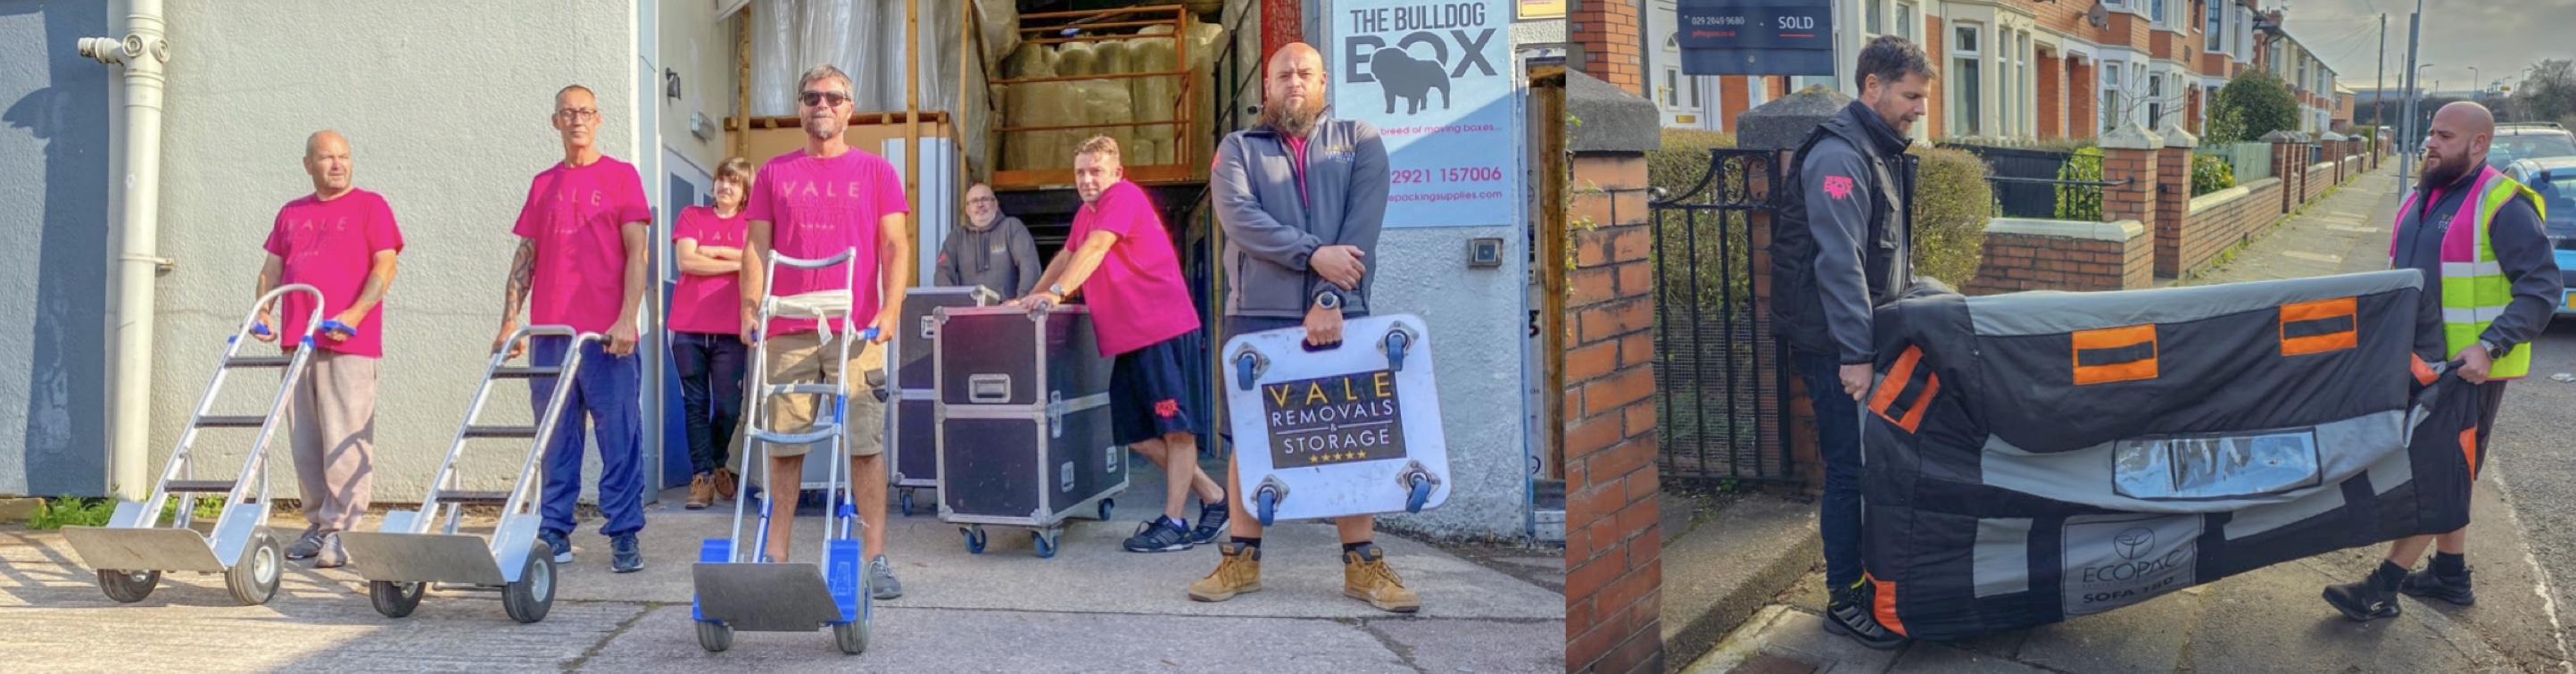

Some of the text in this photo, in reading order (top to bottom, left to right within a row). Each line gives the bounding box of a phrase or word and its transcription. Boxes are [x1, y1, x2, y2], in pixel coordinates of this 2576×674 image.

[1350, 2, 1485, 33] THE BULLDOG
[1692, 16, 1705, 26] 029
[1726, 16, 1744, 26] 9680
[1778, 16, 1814, 29] SOLD
[1346, 28, 1498, 83] BOX
[1381, 127, 1410, 135] breed
[1412, 126, 1421, 134] of
[1425, 124, 1461, 133] moving
[1391, 166, 1503, 184] 2921 157006
[782, 180, 859, 197] VALE
[1269, 371, 1392, 409] VALE
[1271, 399, 1394, 428] REMOVALS
[1330, 423, 1338, 431] &
[1283, 429, 1390, 454] STORAGE
[2083, 549, 2180, 583] ECOPAC
[2083, 589, 2134, 603] SOFA
